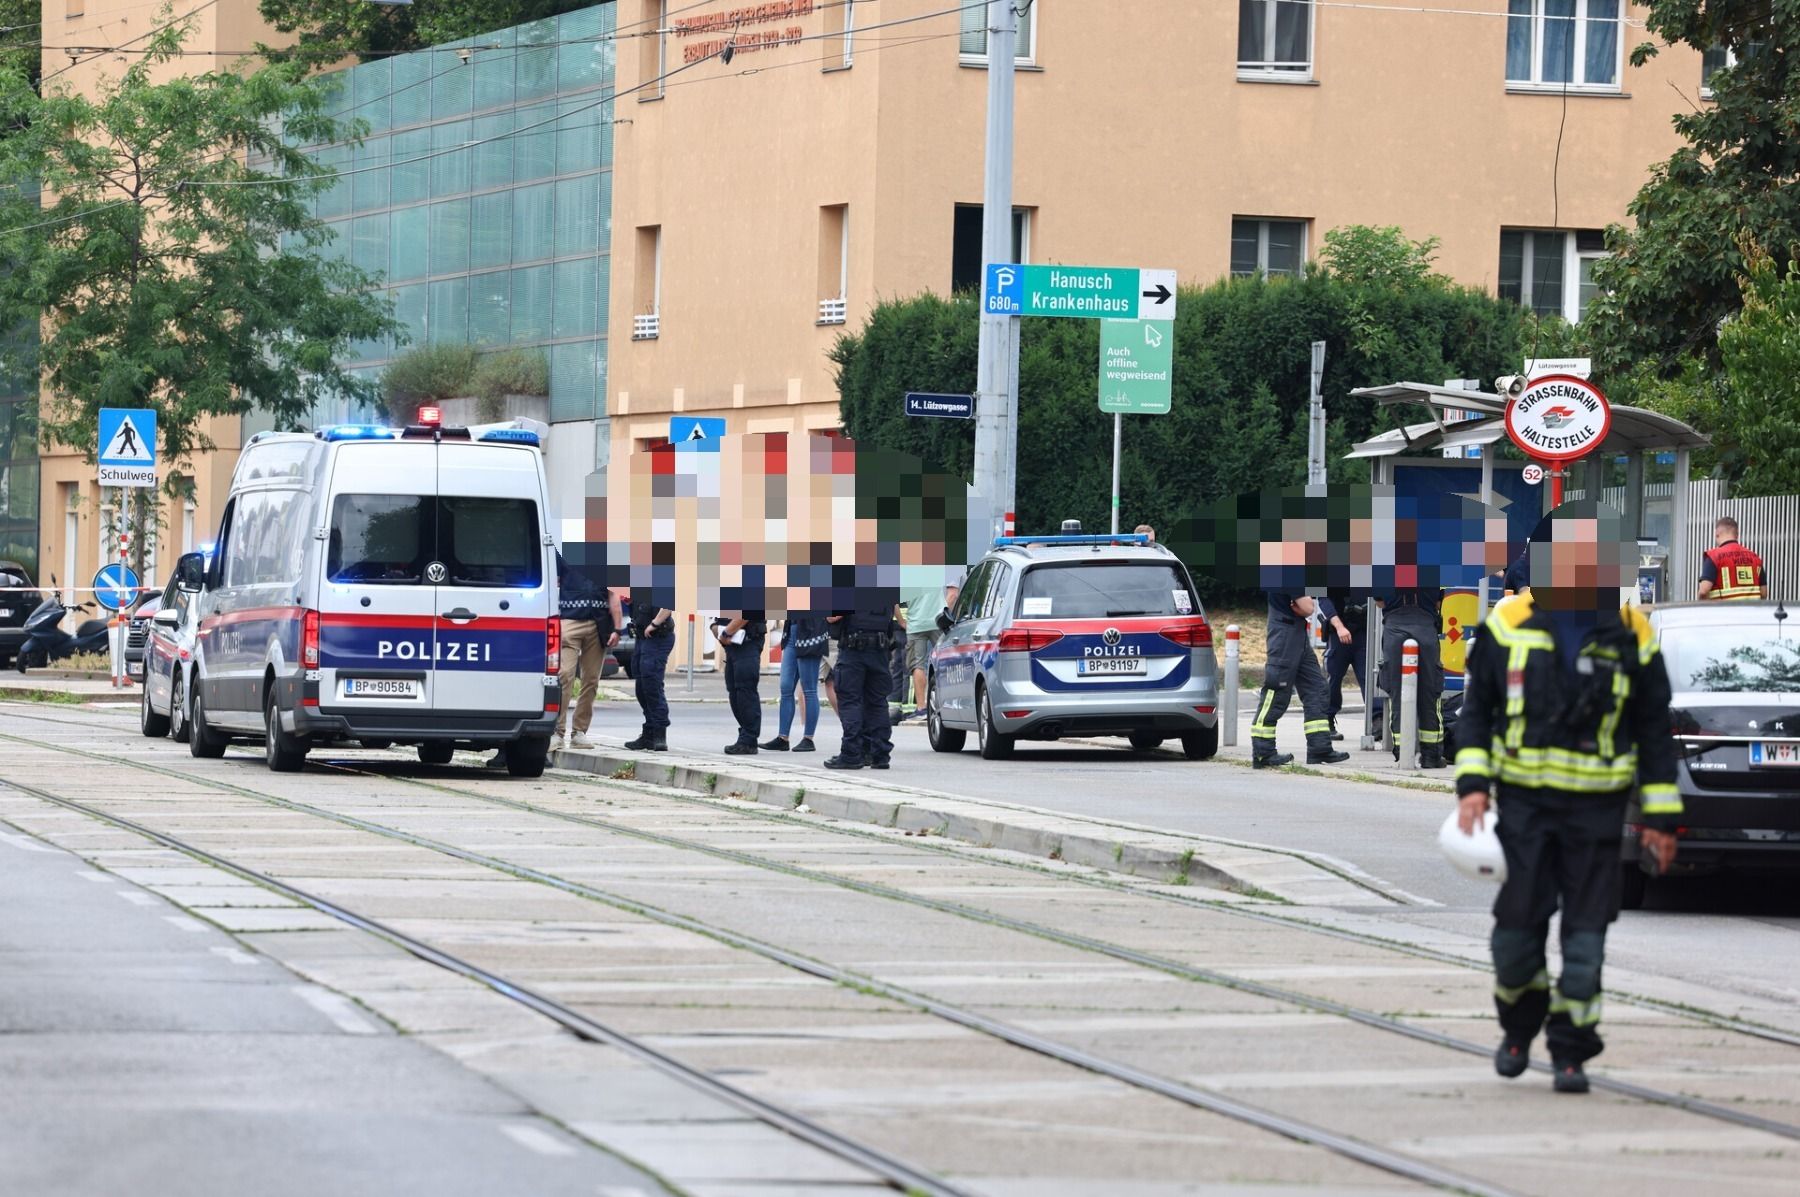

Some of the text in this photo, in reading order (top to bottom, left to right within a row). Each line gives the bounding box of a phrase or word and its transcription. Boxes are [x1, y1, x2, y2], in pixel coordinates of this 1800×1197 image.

[1050, 271, 1112, 290] Hanusch
[1032, 292, 1130, 312] Krankenhaus
[1107, 347, 1131, 356] Auch
[1107, 358, 1138, 368] offline
[1107, 371, 1166, 382] wegweisend
[1518, 385, 1599, 413] STRASSENBAHN
[1521, 425, 1595, 449] HALTESTELLE
[100, 468, 154, 483] Schulweg
[1524, 469, 1541, 481] 52
[1738, 571, 1752, 580] EL
[378, 640, 491, 662] POLIZEI
[1084, 645, 1141, 657] POLIZEI
